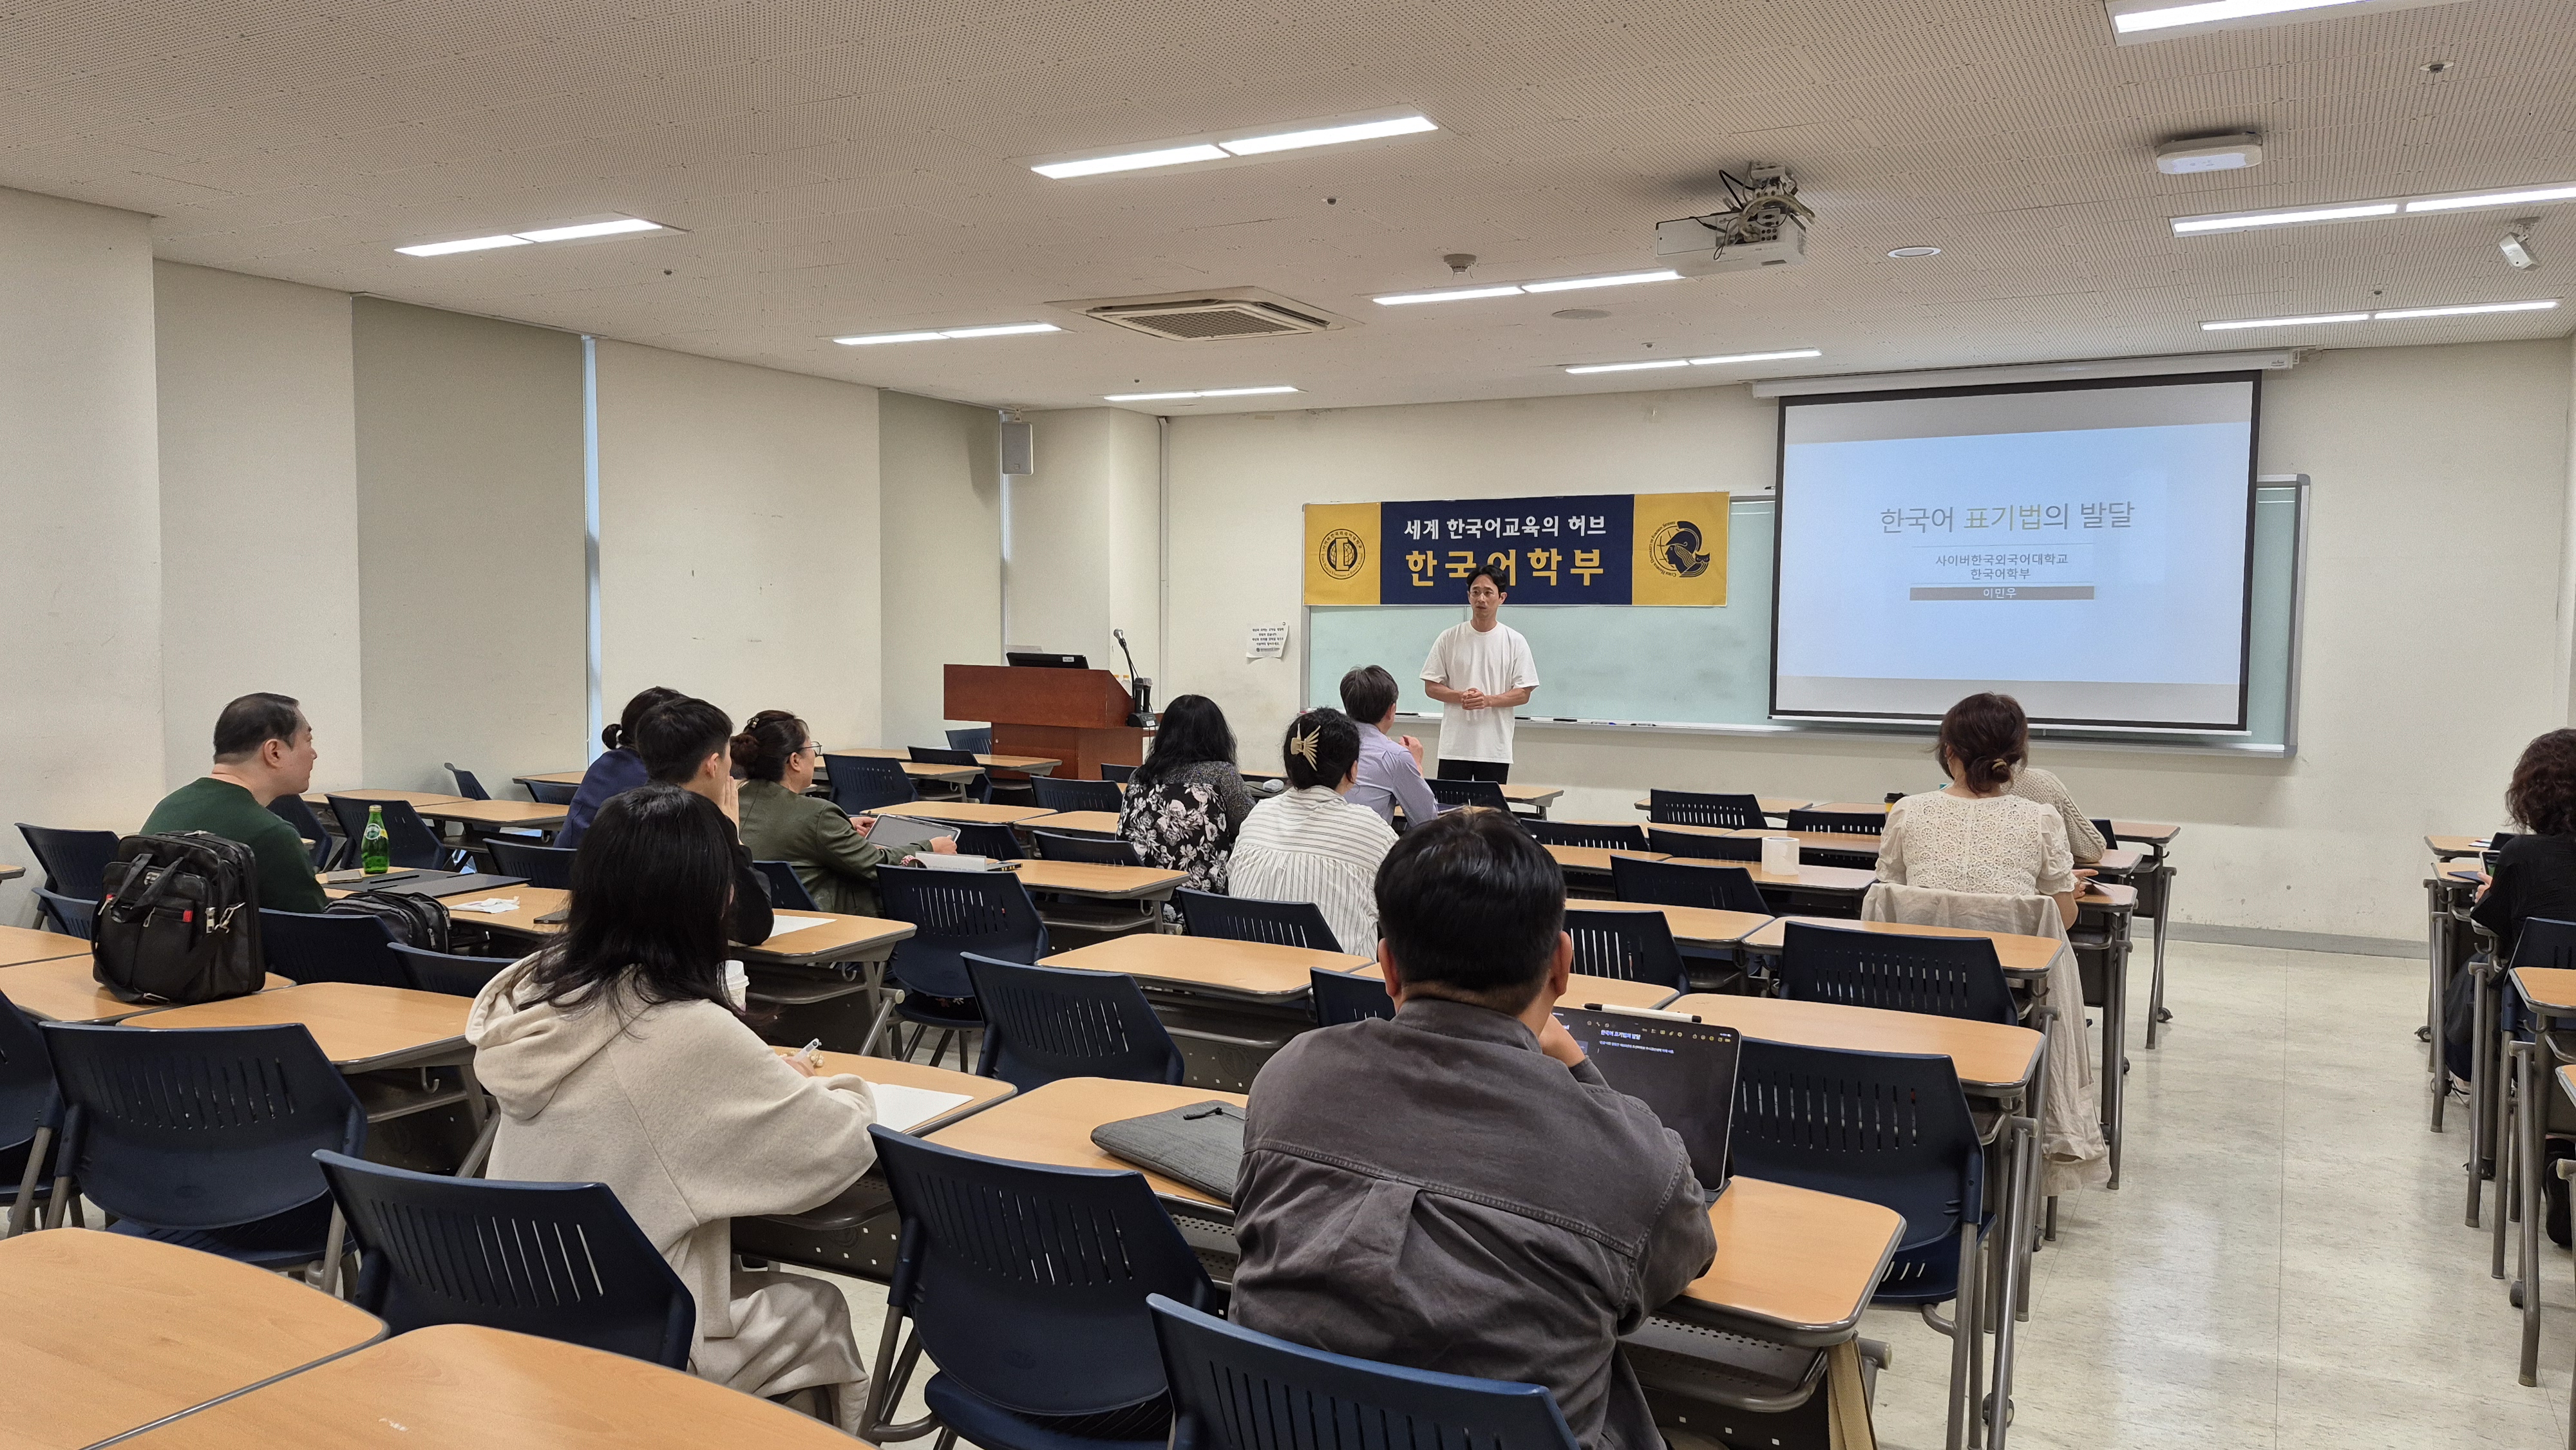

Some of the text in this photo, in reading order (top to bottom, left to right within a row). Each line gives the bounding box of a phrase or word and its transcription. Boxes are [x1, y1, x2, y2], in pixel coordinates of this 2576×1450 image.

[1880, 501, 2136, 534] 한국어 표기법의 발달
[1404, 515, 1607, 540] 세계 한국어교육의 허브
[1405, 548, 1604, 587] 한국어학부
[1935, 553, 2069, 567] 사이버한국외국어대학교
[1970, 568, 2032, 580] 한국어학부
[1983, 587, 2017, 599] 이민우
